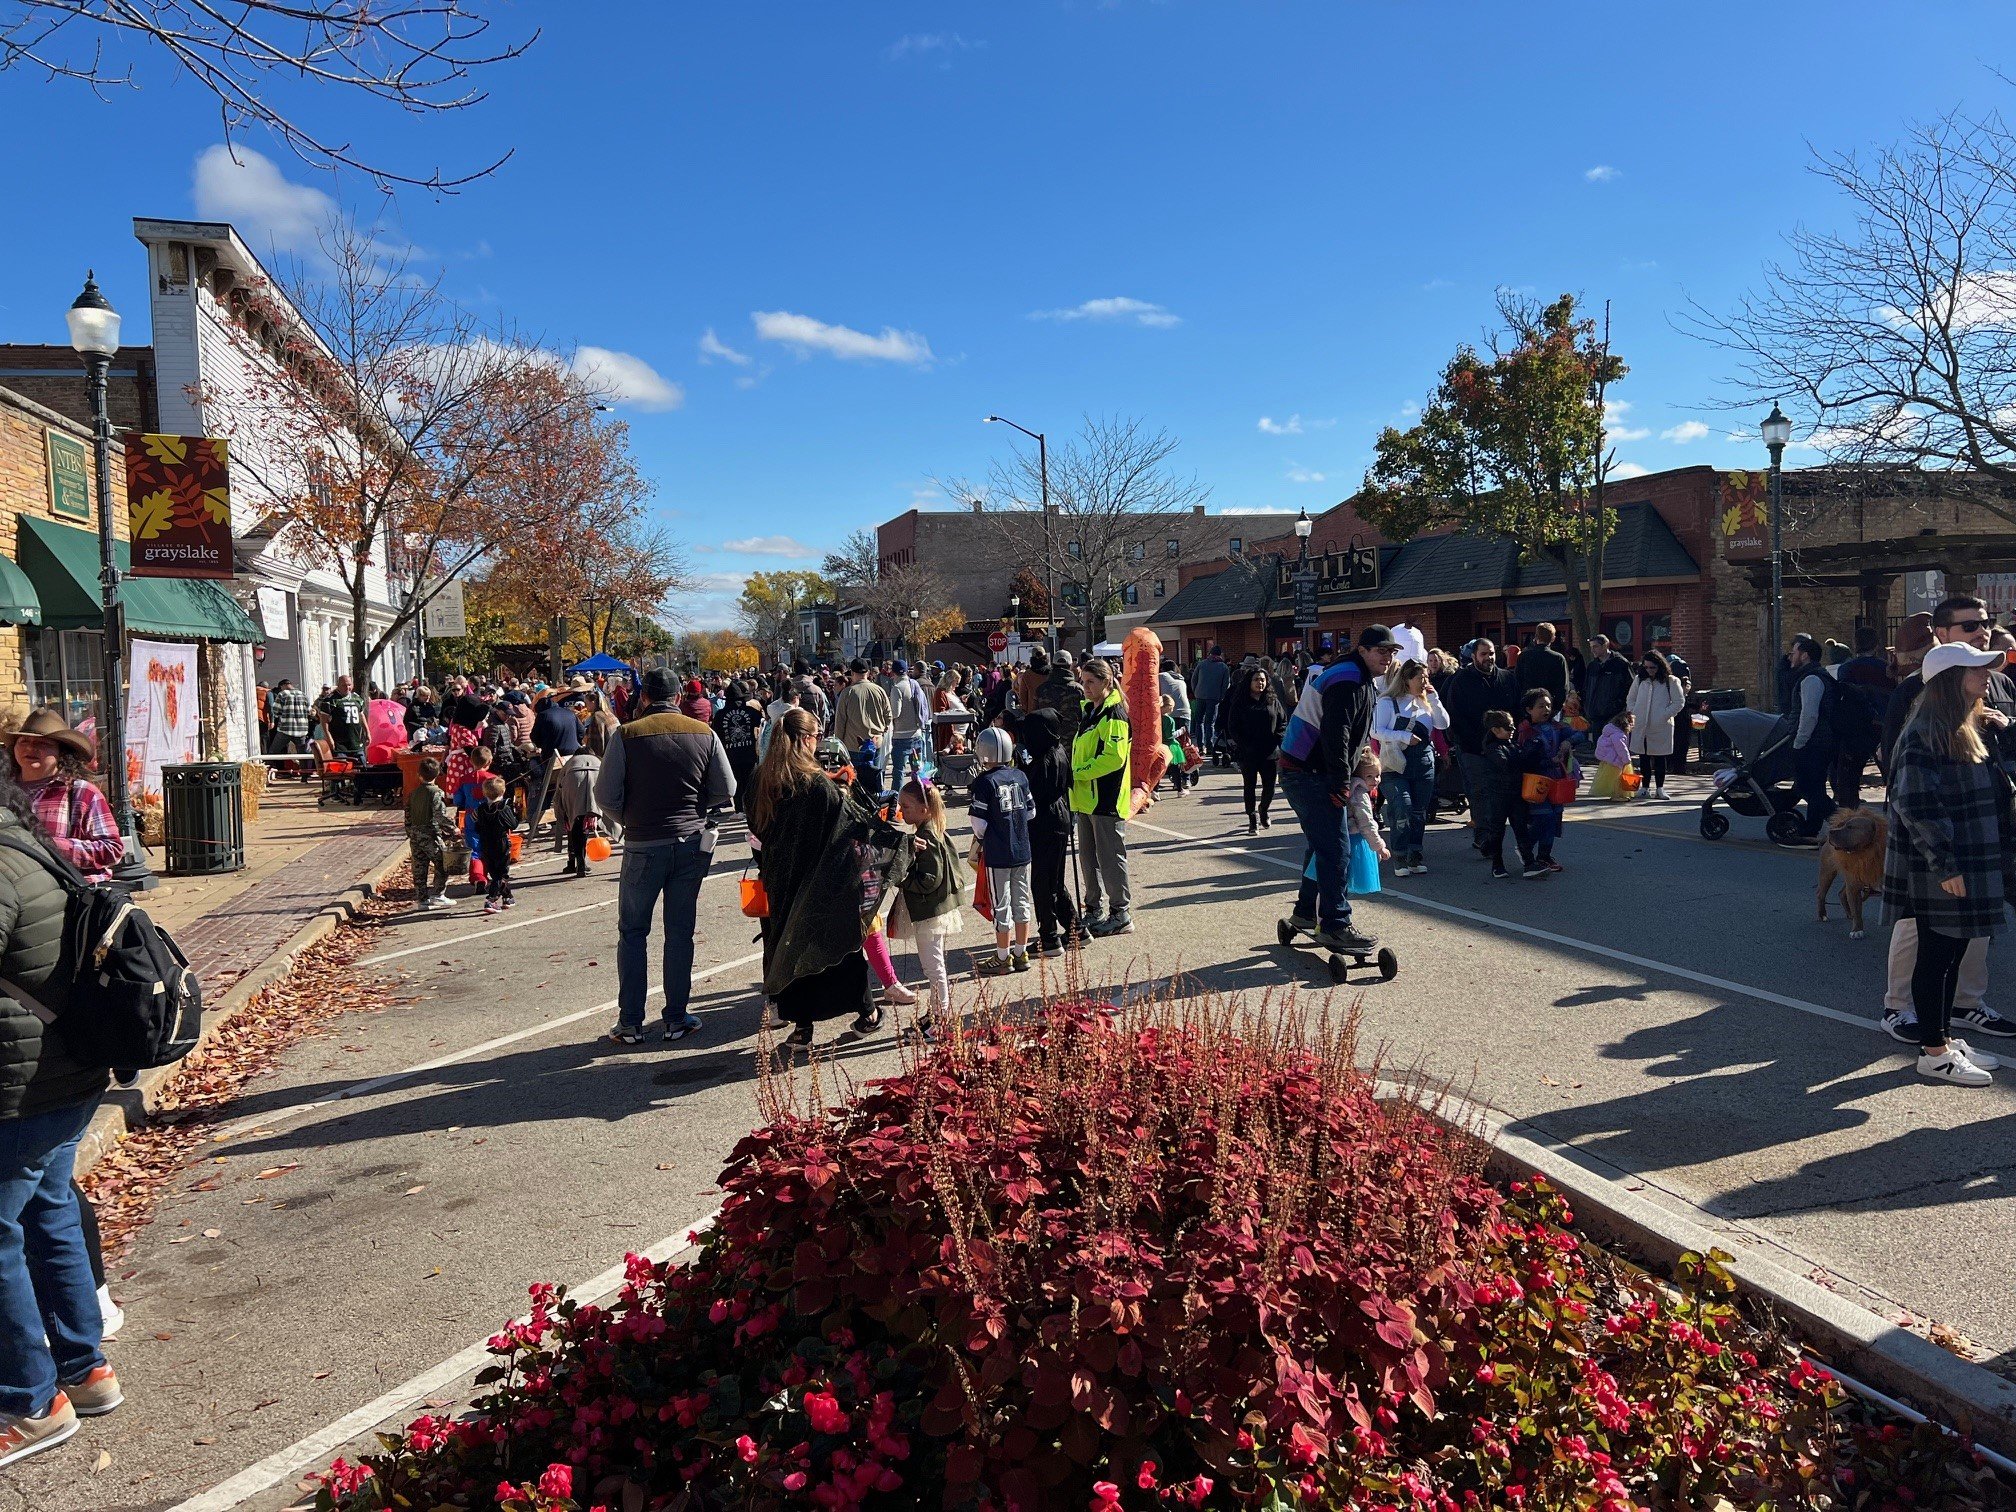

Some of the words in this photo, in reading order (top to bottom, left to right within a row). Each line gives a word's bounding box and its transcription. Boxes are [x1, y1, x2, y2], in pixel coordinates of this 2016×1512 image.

[56, 447, 82, 475] NTBS
[1729, 537, 1763, 550] grayslake
[145, 545, 219, 561] grayslake
[989, 638, 1007, 647] STOP
[343, 705, 360, 724] 79
[997, 782, 1025, 812] 21
